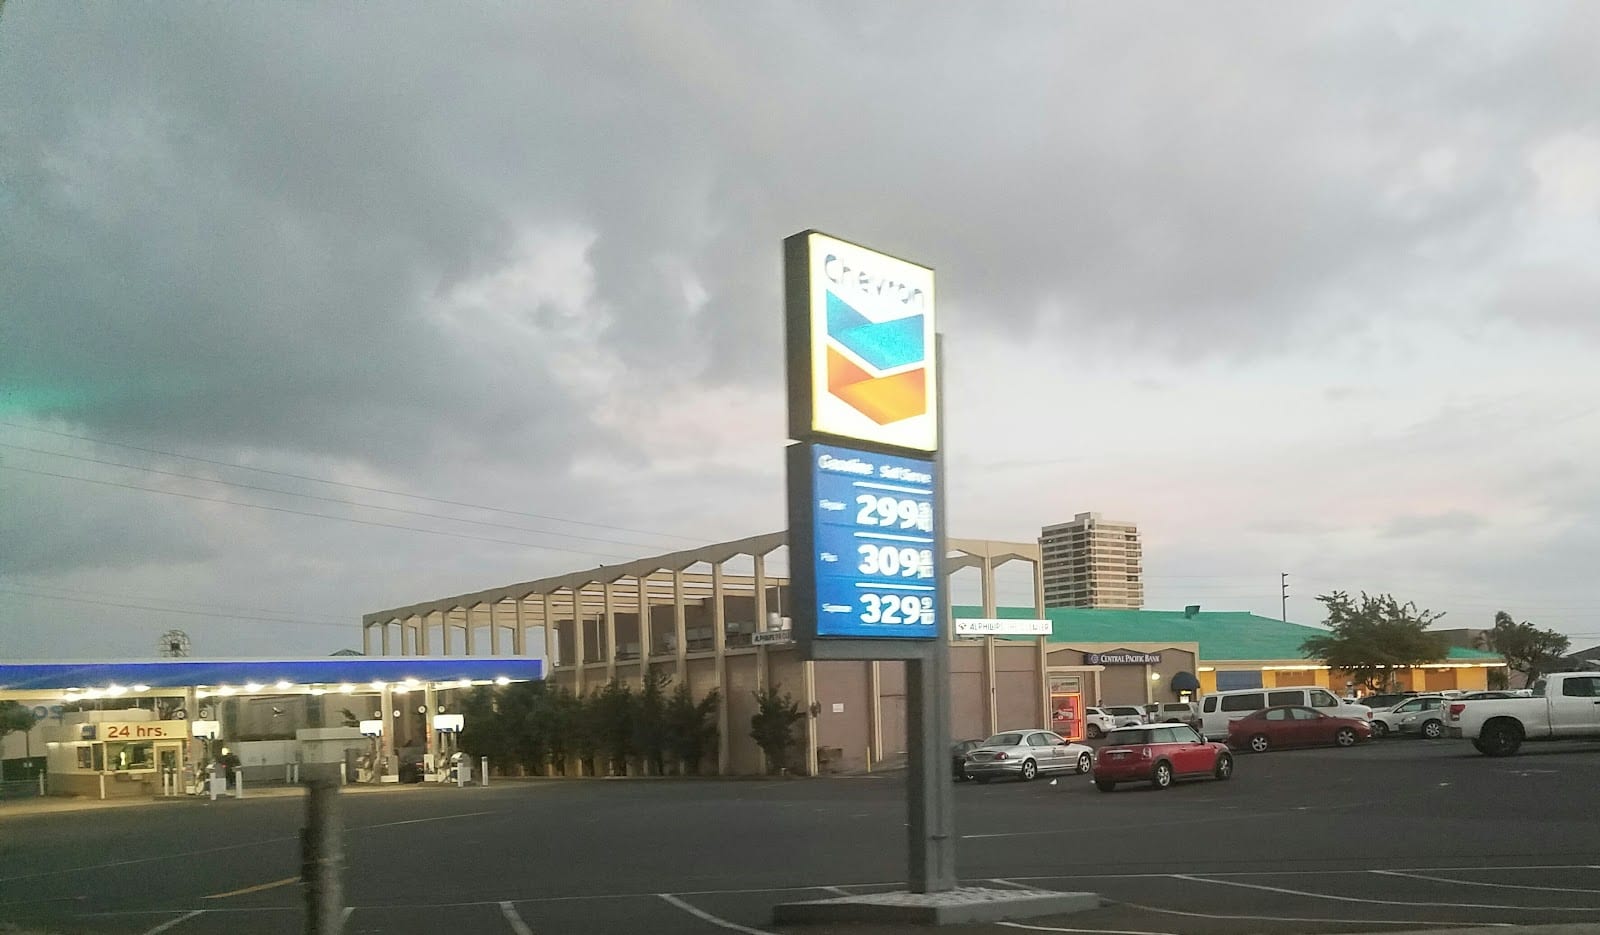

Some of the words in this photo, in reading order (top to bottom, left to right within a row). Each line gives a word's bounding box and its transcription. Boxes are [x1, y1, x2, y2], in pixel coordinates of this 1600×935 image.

[855, 494, 919, 529] 299
[857, 543, 920, 577] 309
[860, 593, 921, 624] 329
[1100, 654, 1125, 663] CENTRAL
[1125, 654, 1145, 663] PACIFIC
[1144, 654, 1160, 663] BANK
[108, 726, 130, 738] 24
[136, 725, 168, 737] hrs.
